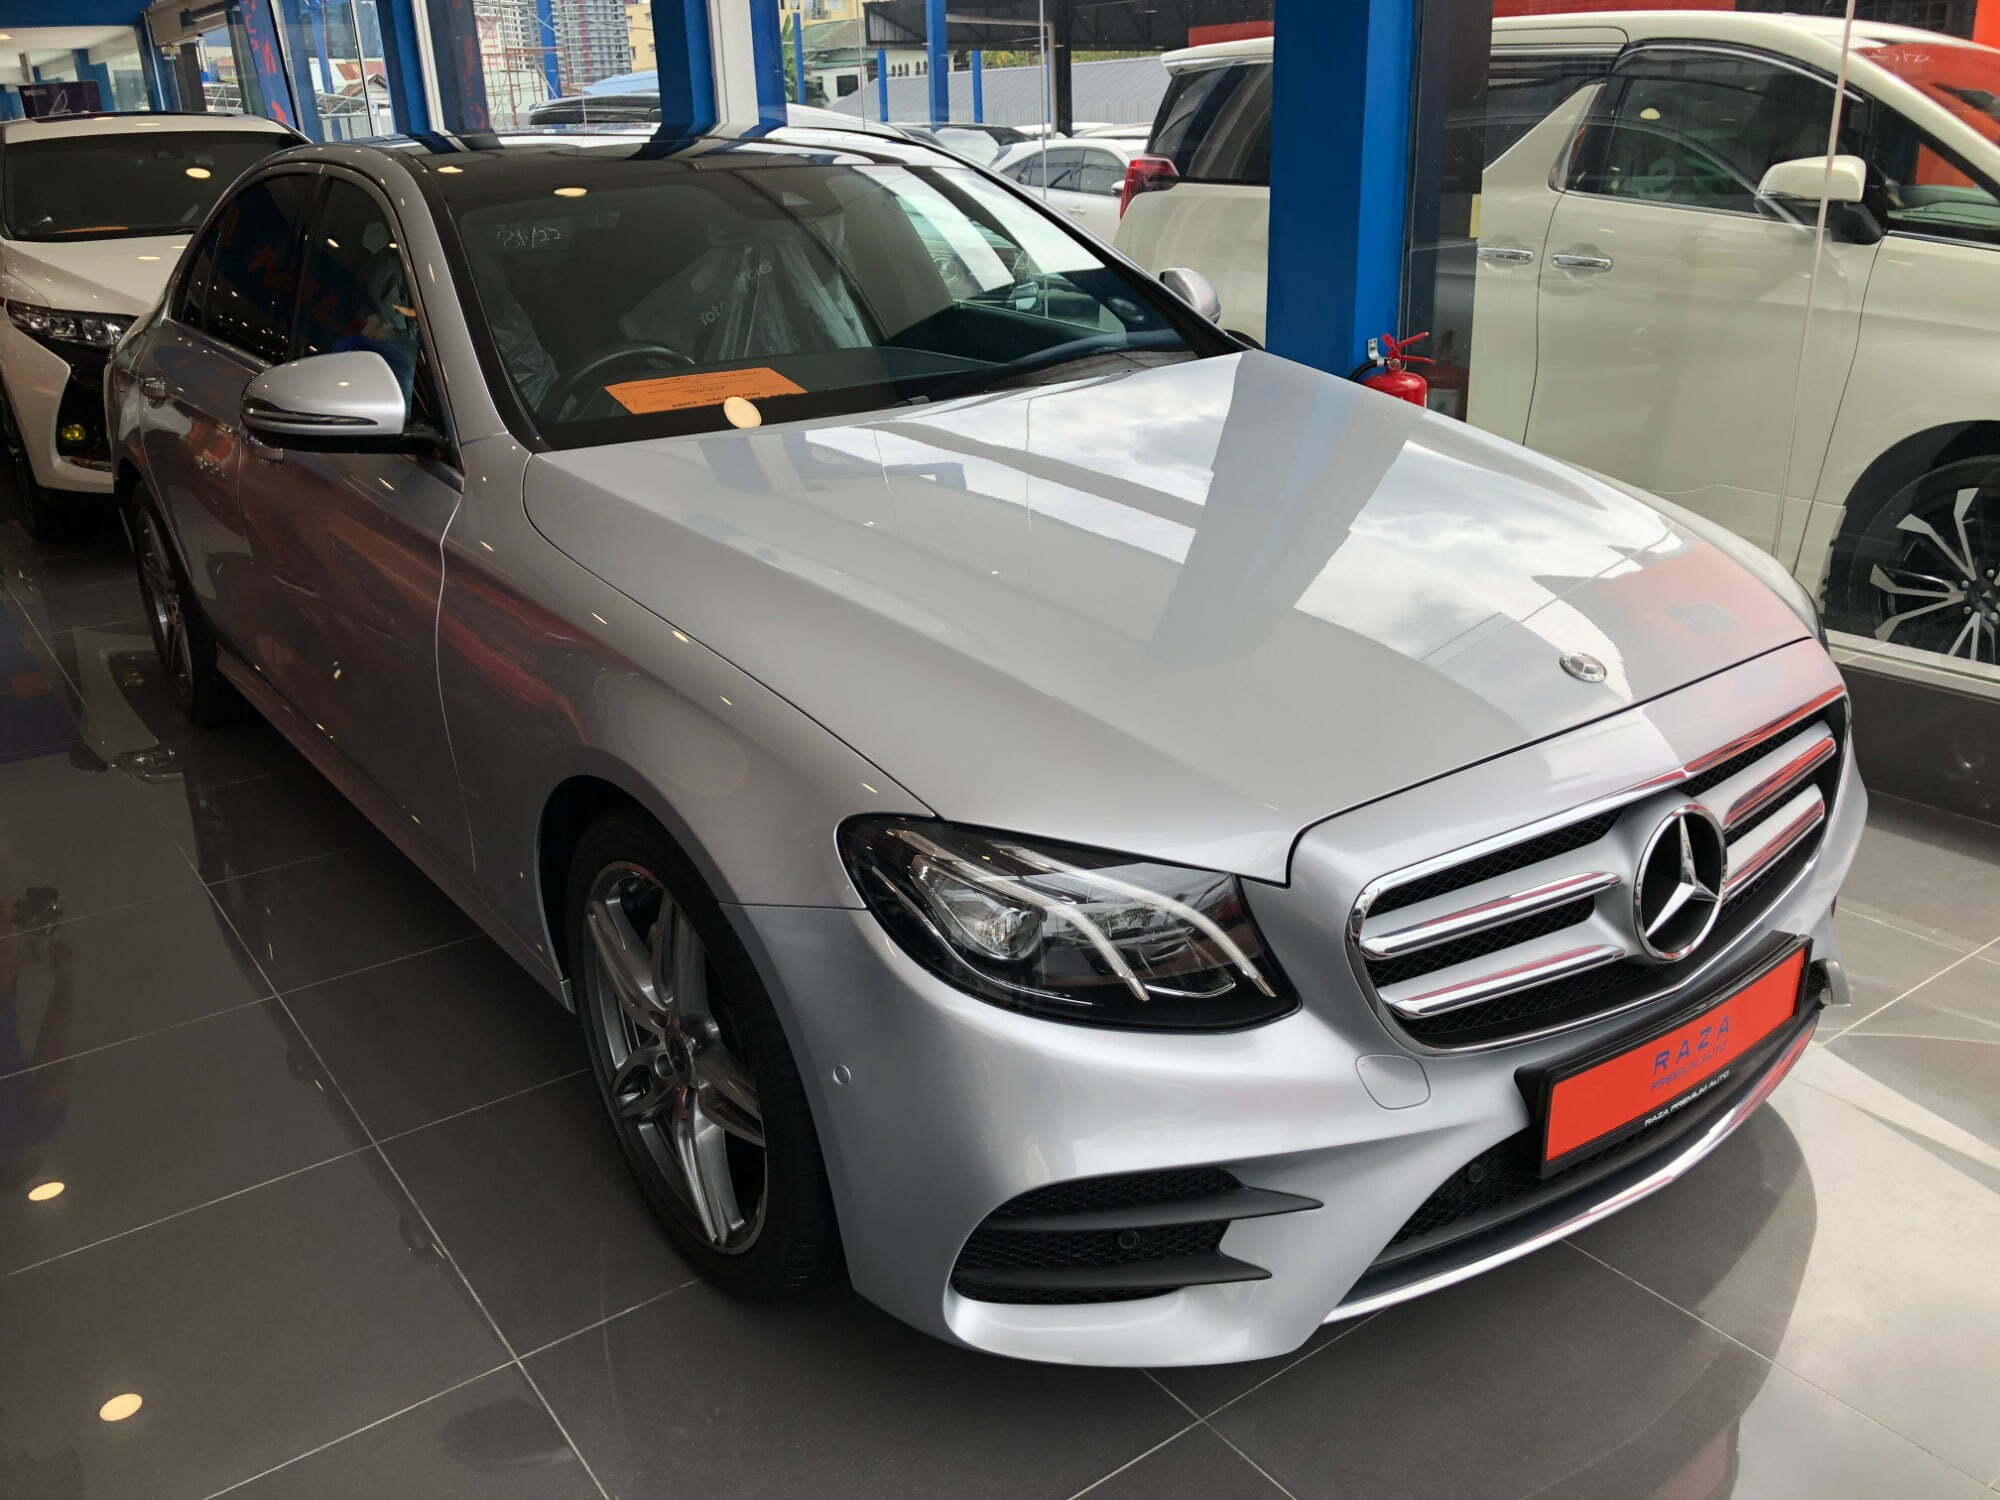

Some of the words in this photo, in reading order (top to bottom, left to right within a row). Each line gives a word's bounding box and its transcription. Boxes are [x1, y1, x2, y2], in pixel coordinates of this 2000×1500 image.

[1650, 1059, 1700, 1094] PREMIUM
[1702, 1040, 1728, 1062] AUTO
[1653, 1016, 1729, 1074] RAZA
[1644, 1108, 1670, 1127] RAZA
[1670, 1084, 1708, 1112] PREMIUM
[1708, 1069, 1731, 1089] AUTO
